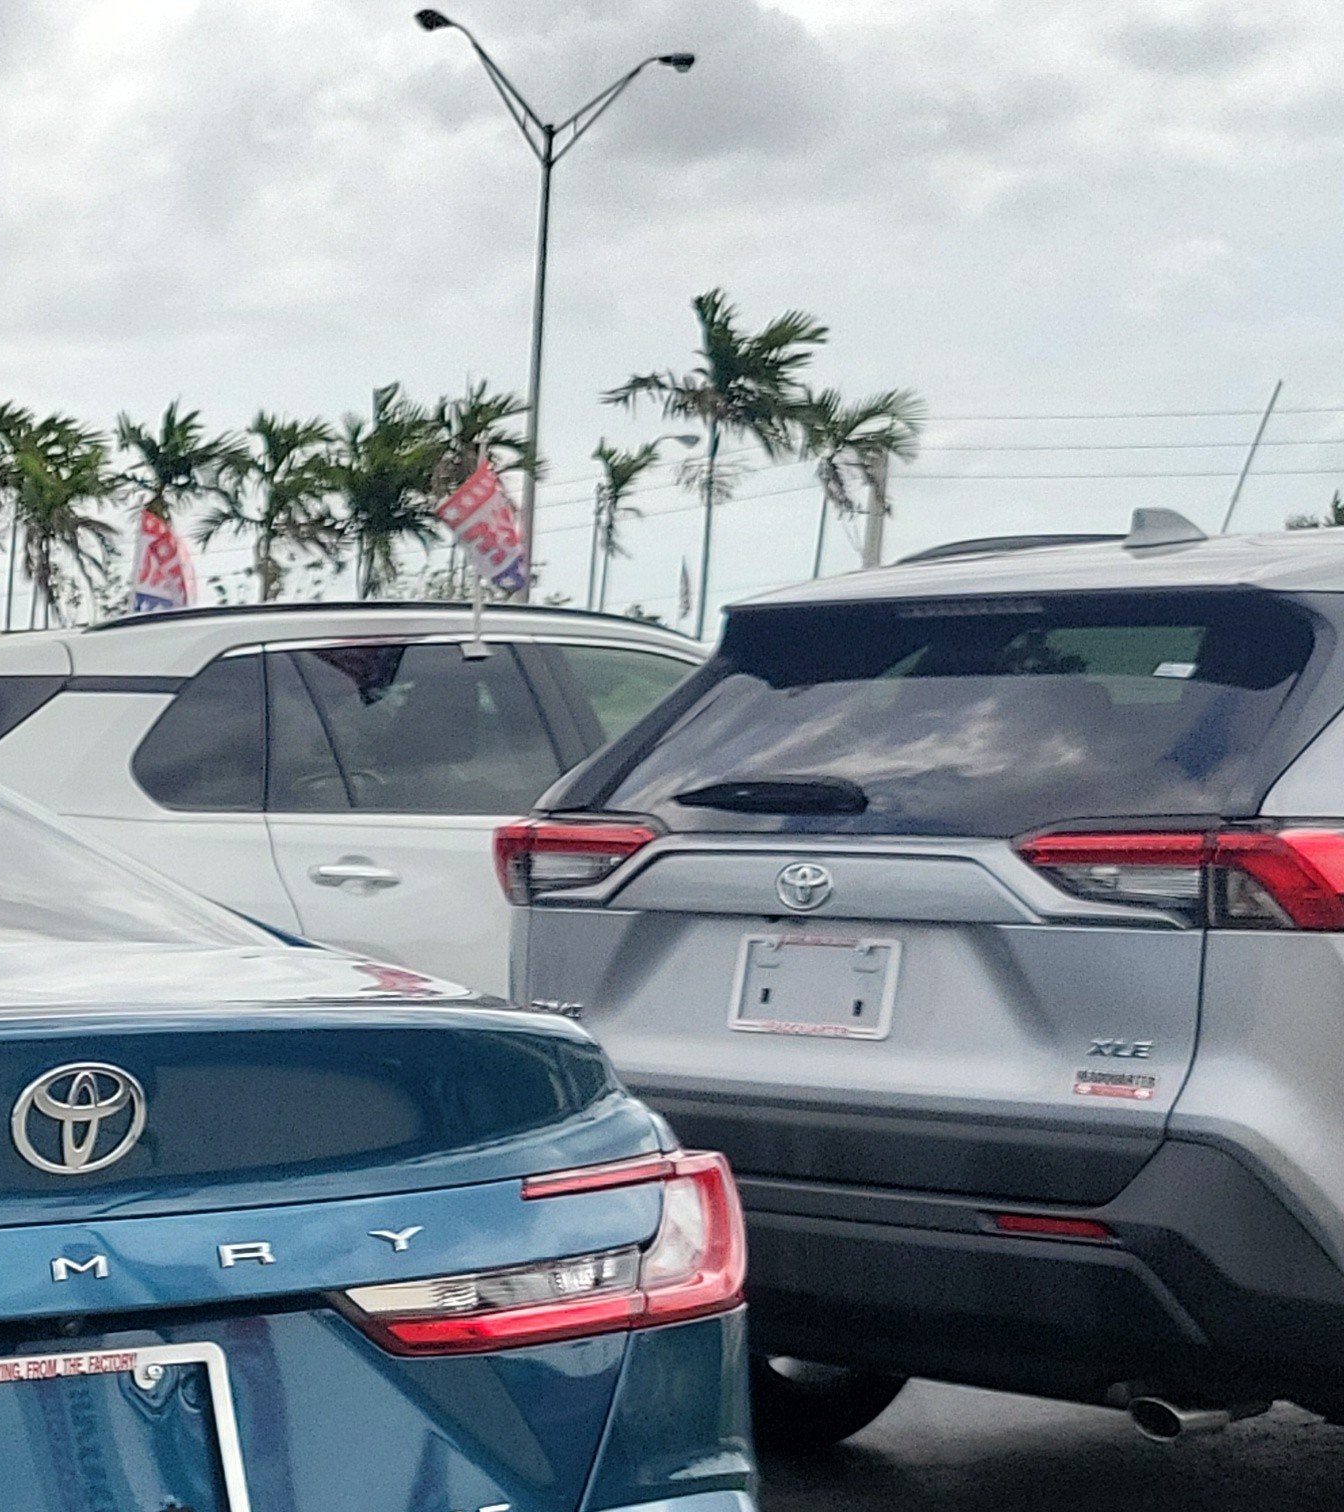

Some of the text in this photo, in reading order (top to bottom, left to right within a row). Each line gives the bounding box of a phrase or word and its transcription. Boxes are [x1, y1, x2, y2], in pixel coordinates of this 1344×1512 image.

[1086, 1039, 1154, 1059] XLE
[26, 1360, 57, 1379] FROM
[63, 1357, 84, 1375] THE
